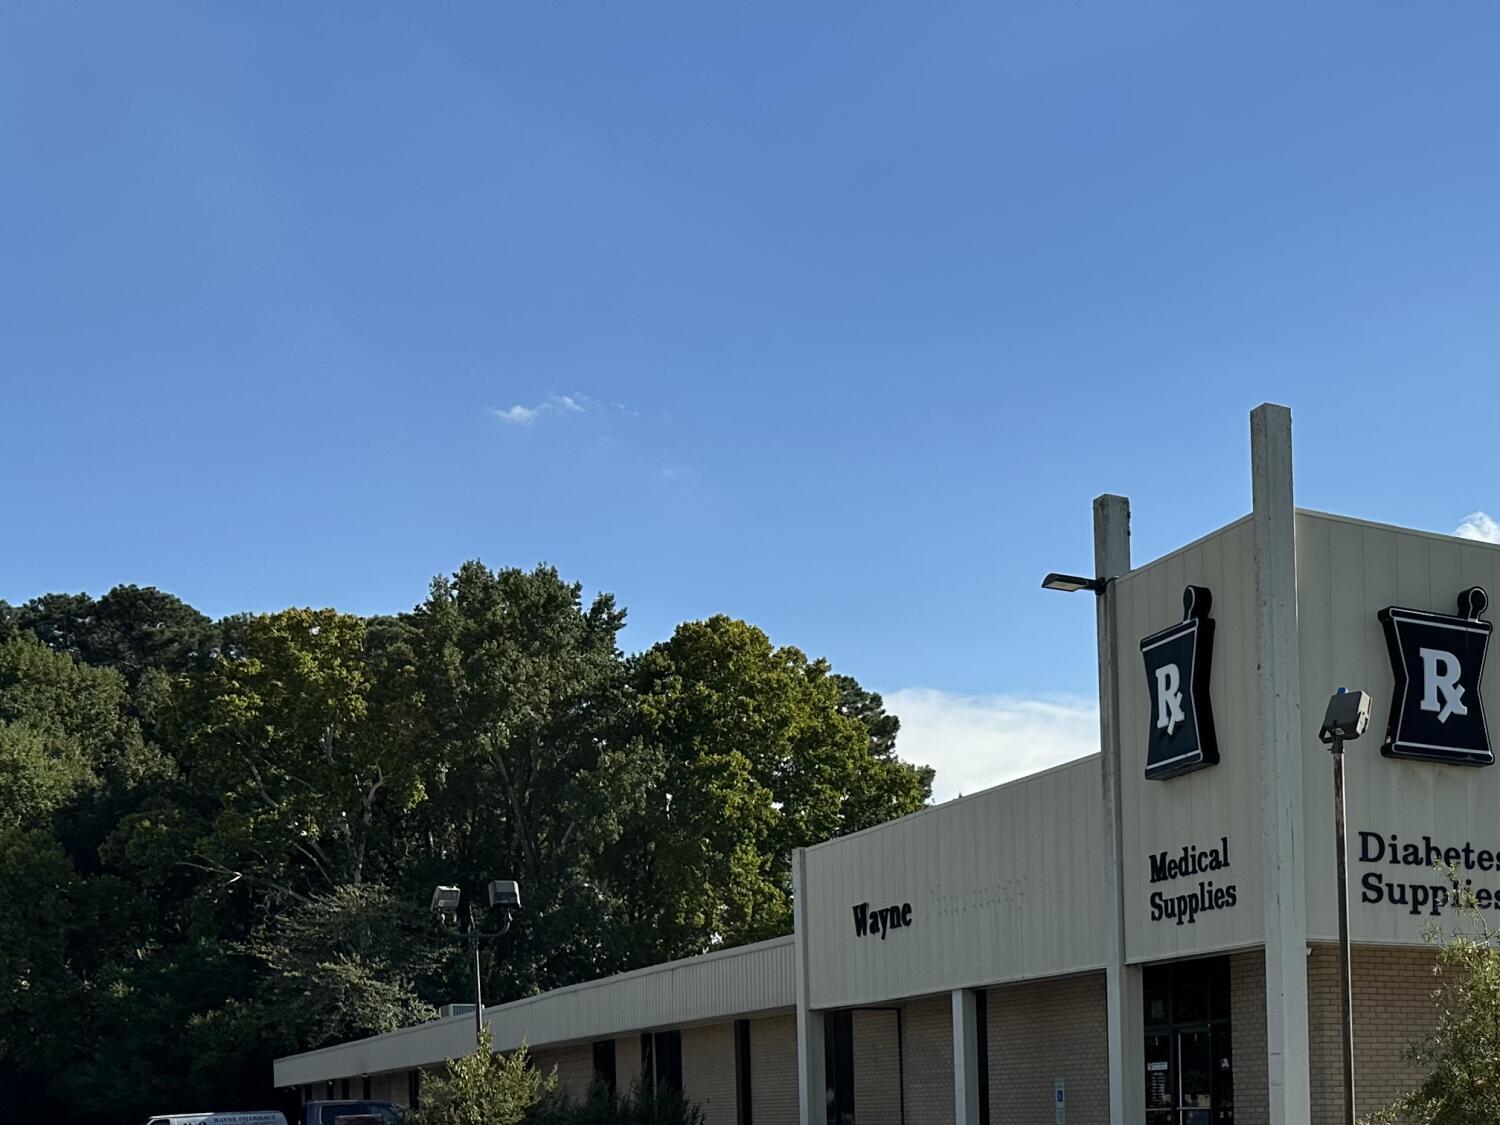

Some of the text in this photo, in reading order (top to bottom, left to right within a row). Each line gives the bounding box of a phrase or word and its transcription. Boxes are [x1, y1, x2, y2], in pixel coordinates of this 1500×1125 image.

[1149, 837, 1231, 883] Medical
[852, 902, 913, 940] Wayne
[1150, 881, 1237, 926] Supplies
